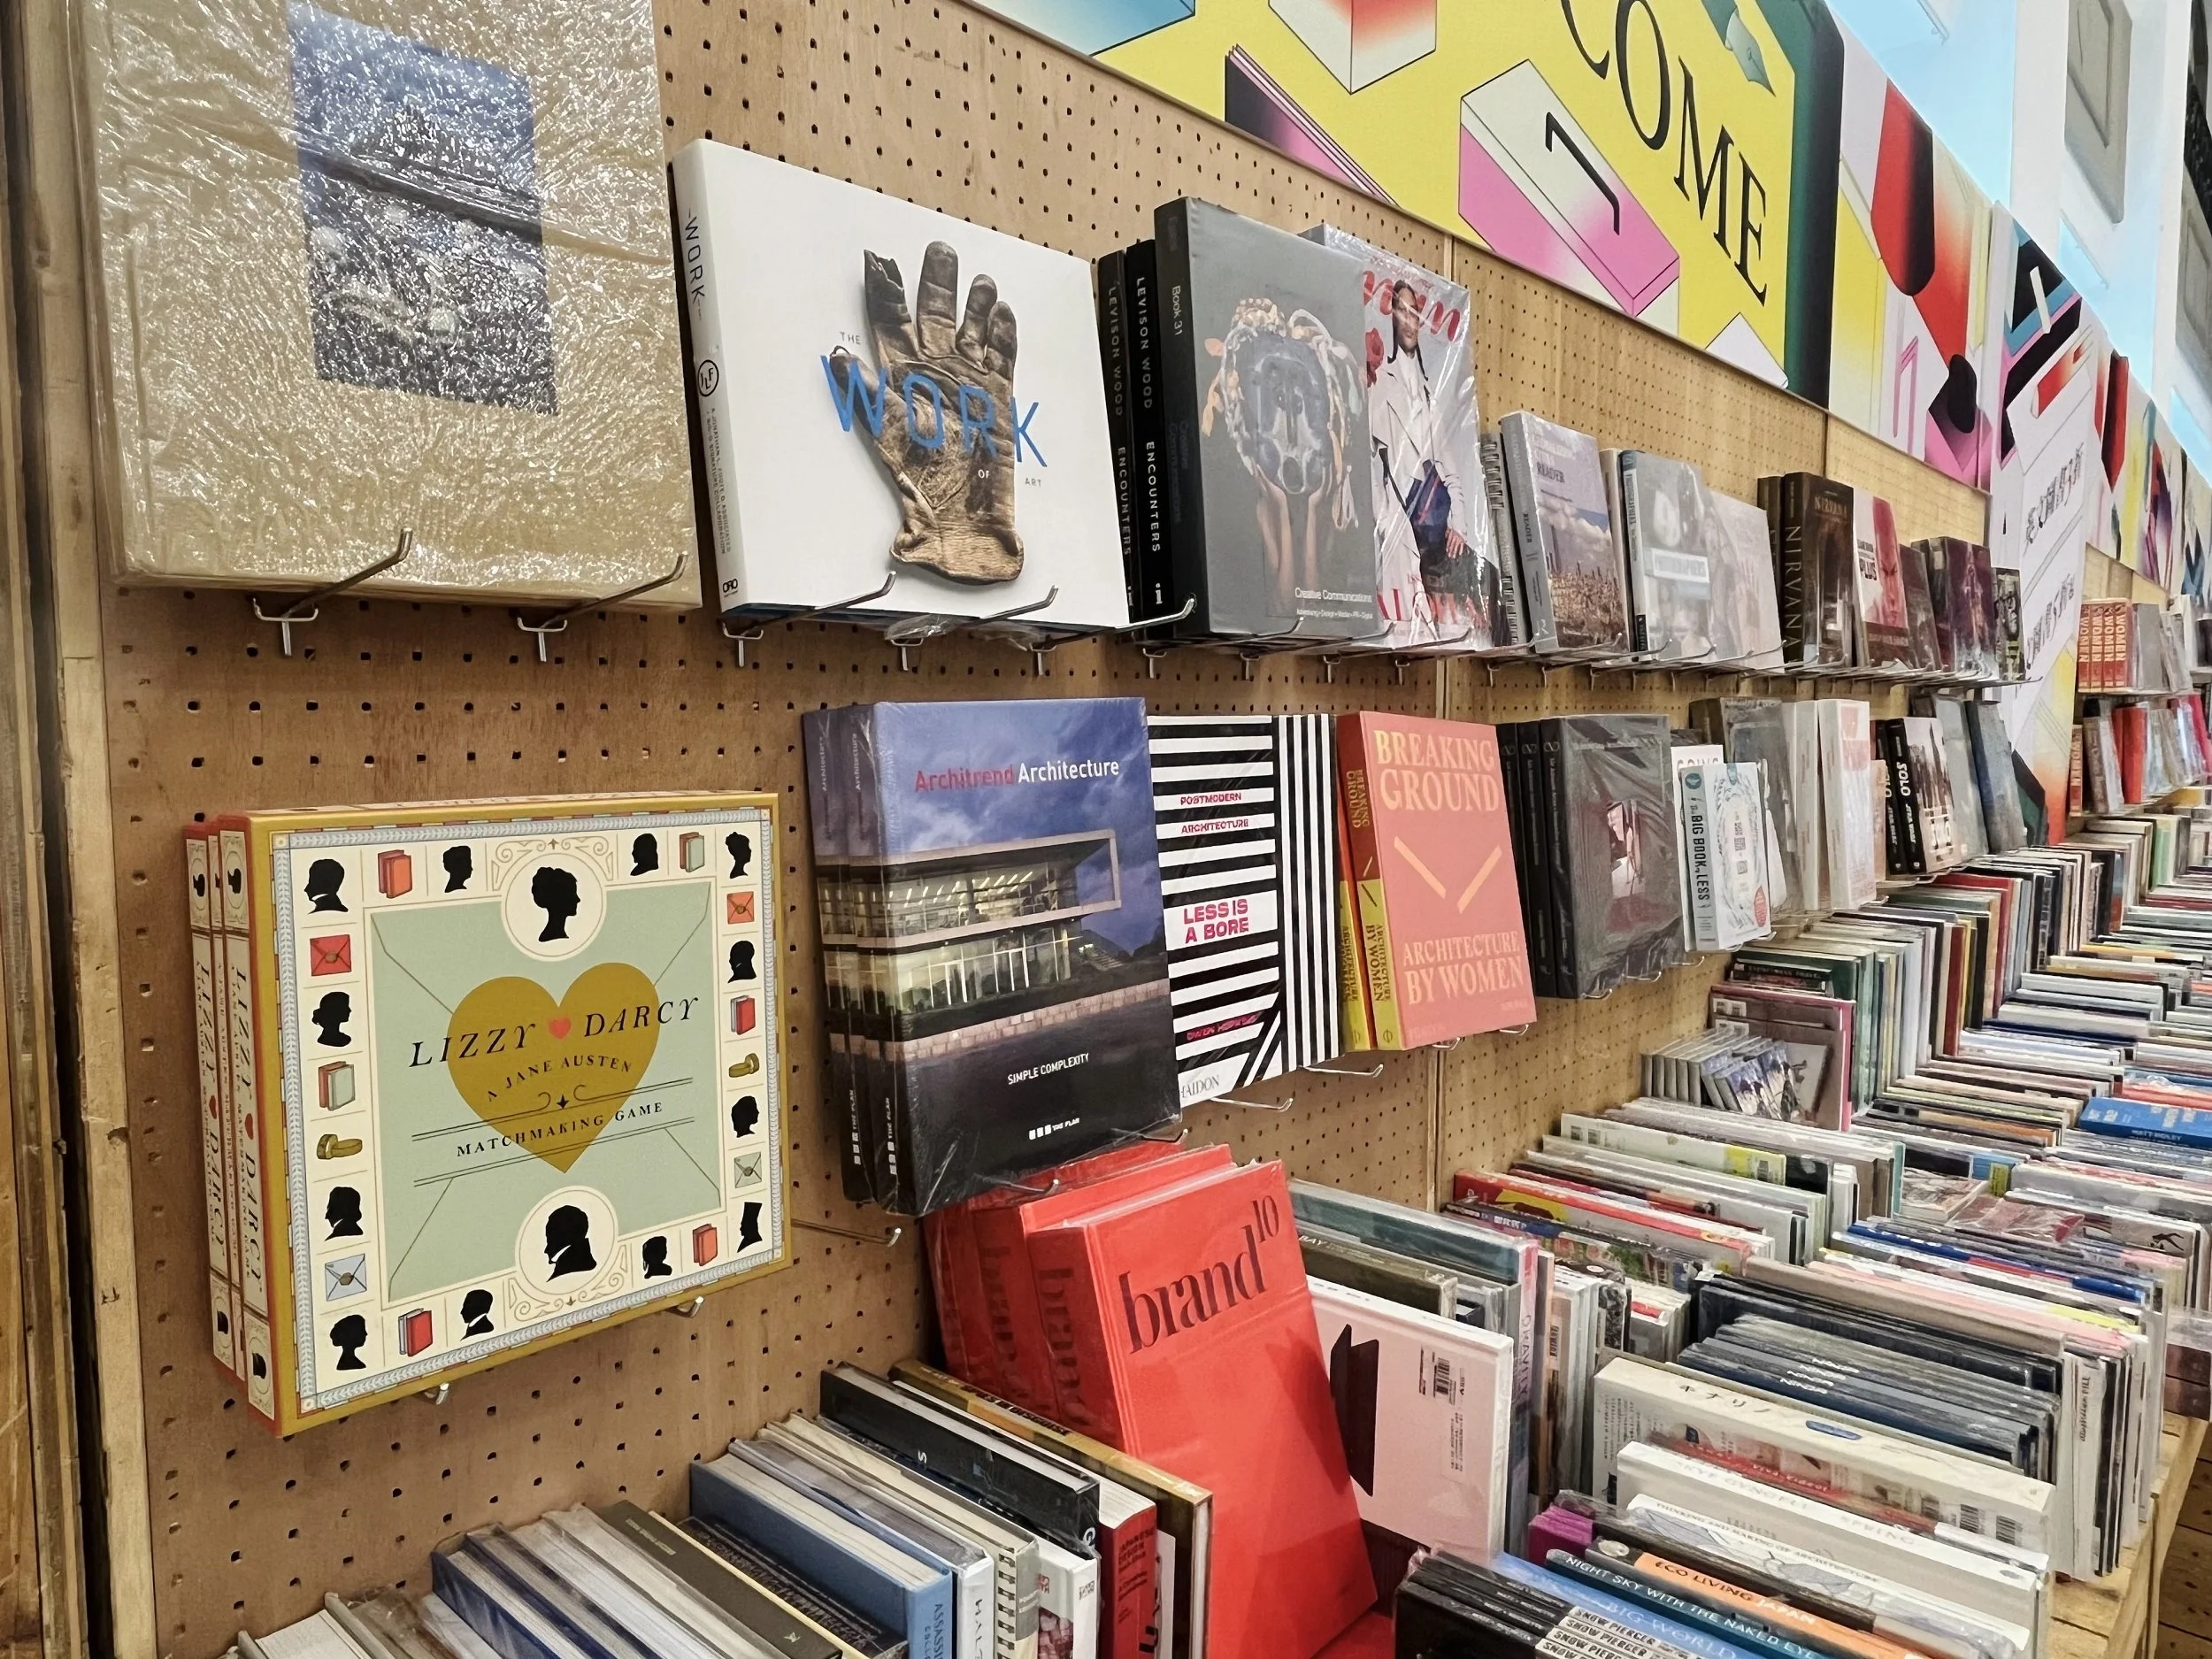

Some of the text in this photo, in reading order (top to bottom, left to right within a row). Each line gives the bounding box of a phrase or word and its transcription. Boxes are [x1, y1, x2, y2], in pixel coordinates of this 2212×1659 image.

[685, 216, 705, 305] WORK
[1171, 285, 1183, 335] Book 31
[840, 331, 860, 345] THE
[820, 356, 1048, 467] WORK
[1108, 286, 1131, 555] LEVISON WOOD ENCOUNTERS
[1136, 277, 1161, 552] LEVISON WOOD ENCOUNTERS
[978, 469, 990, 480] OF
[1025, 477, 1042, 488] ART
[1785, 526, 1803, 647] NIRVANA
[1373, 730, 1495, 772] BREAKING
[915, 760, 1120, 792] Architrend Architecture
[1379, 768, 1500, 813] GROUND
[1897, 762, 1911, 796] SOLO
[1180, 793, 1242, 805] POSTMODERN
[1346, 771, 1361, 828] GROUND
[1181, 818, 1249, 833] ARCHITECTURE
[1692, 815, 1704, 835] BIG
[1694, 838, 1707, 868] BOOK
[1697, 873, 1709, 901] LESS
[1184, 898, 1248, 925] LESS IS
[1186, 917, 1249, 944] A BORE
[1365, 925, 1383, 1002] BY WOMEN
[1376, 924, 1391, 1001] ARCHITECTURE
[1403, 931, 1520, 966] ARCHITECTURE
[1405, 956, 1524, 1005] BY WOMEN
[409, 996, 699, 1069] LIZZY DARCY
[504, 1065, 553, 1090] JANE
[559, 1053, 632, 1073] AUSTEN
[1007, 1053, 1089, 1086] SIMPLE COMPLEXITY
[235, 965, 263, 1291] LIZZY DARCY
[455, 1101, 664, 1157] MATCHMAKING GAME
[1065, 1118, 1079, 1127] PLAN
[1253, 1194, 1280, 1244] 10
[1118, 1225, 1266, 1356] brand
[1565, 1555, 1609, 1580] NIGHT
[1612, 1575, 1643, 1592] SKY
[1646, 1587, 1686, 1609] WITH
[1689, 1604, 1721, 1623] THE
[1723, 1618, 1779, 1647] NAKED
[1655, 1560, 1816, 1625] ECO LIVING JAPAN
[1553, 1630, 1586, 1648] SNOW
[1565, 1618, 1648, 1658] SNOW PIERCER
[1575, 1608, 1656, 1645] SNOW PIERCER
